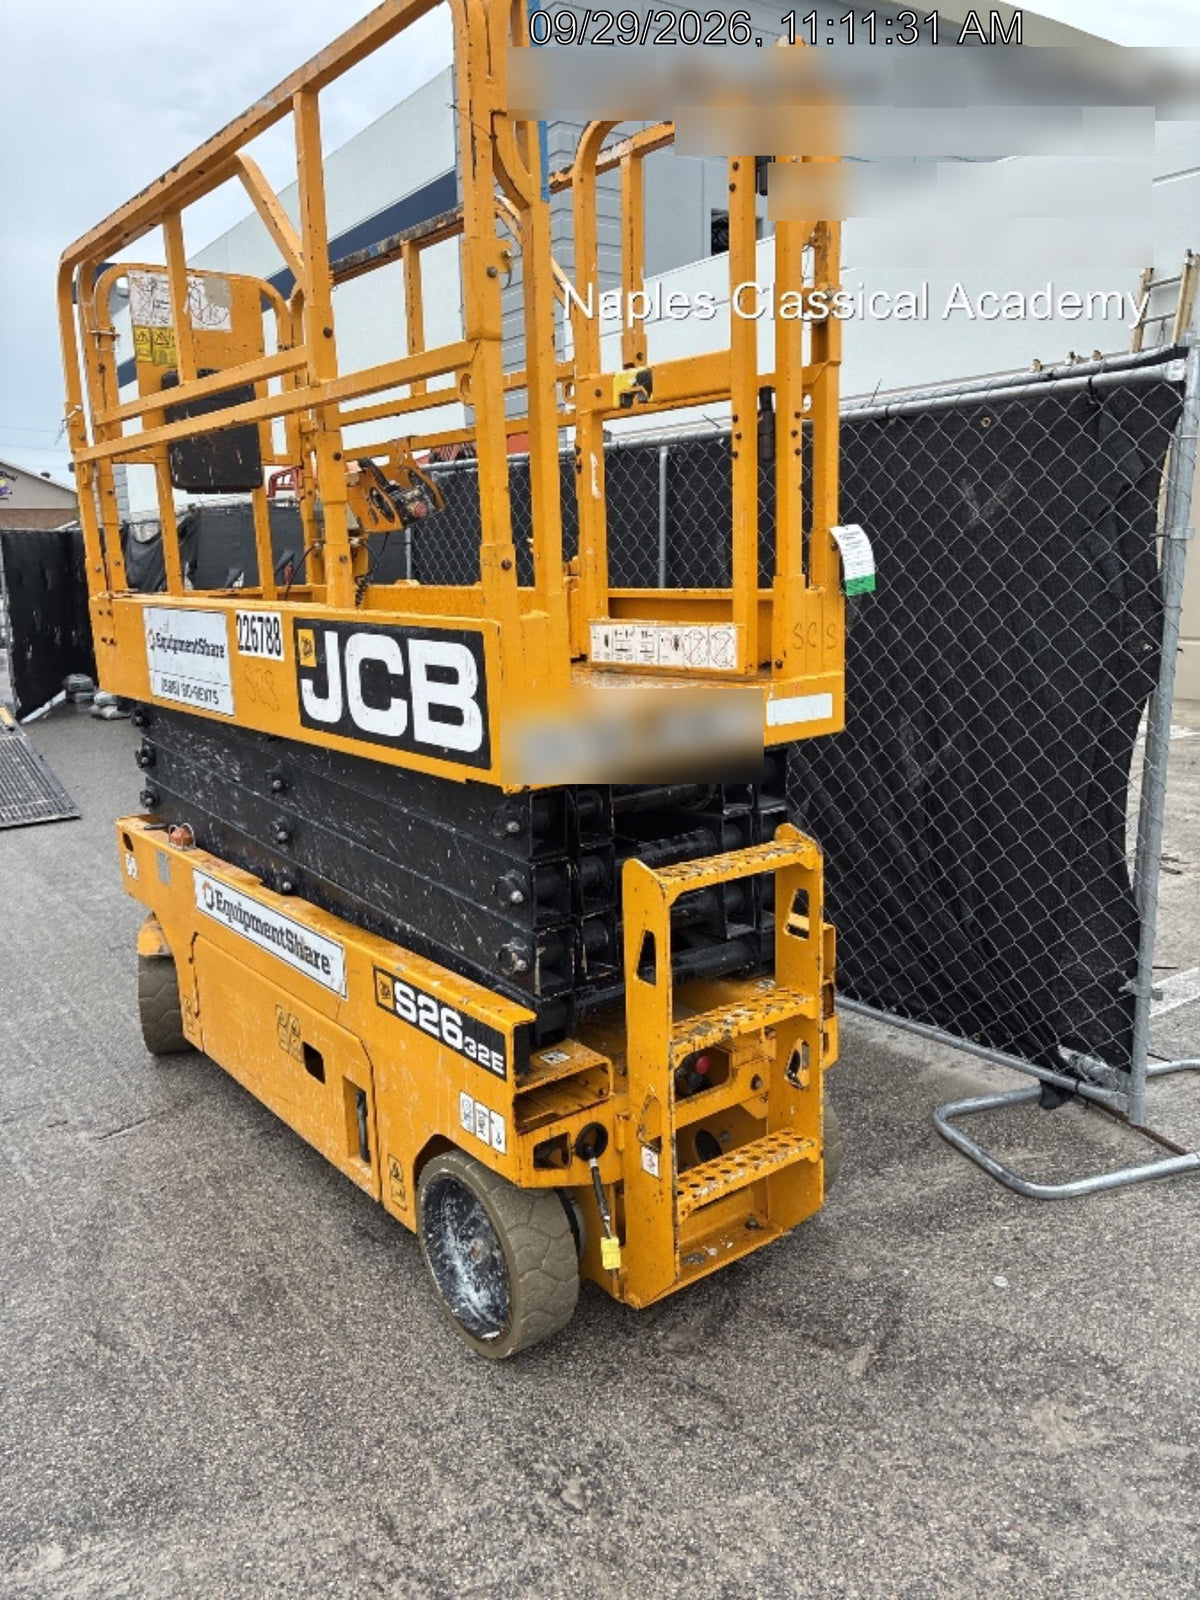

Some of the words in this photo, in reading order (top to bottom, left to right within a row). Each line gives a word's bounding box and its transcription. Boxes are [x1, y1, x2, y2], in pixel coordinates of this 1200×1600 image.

[155, 632, 225, 658] EquipmentShare
[235, 613, 282, 657] 226788
[300, 630, 483, 753] JCB
[214, 889, 331, 975] EquipmentShare
